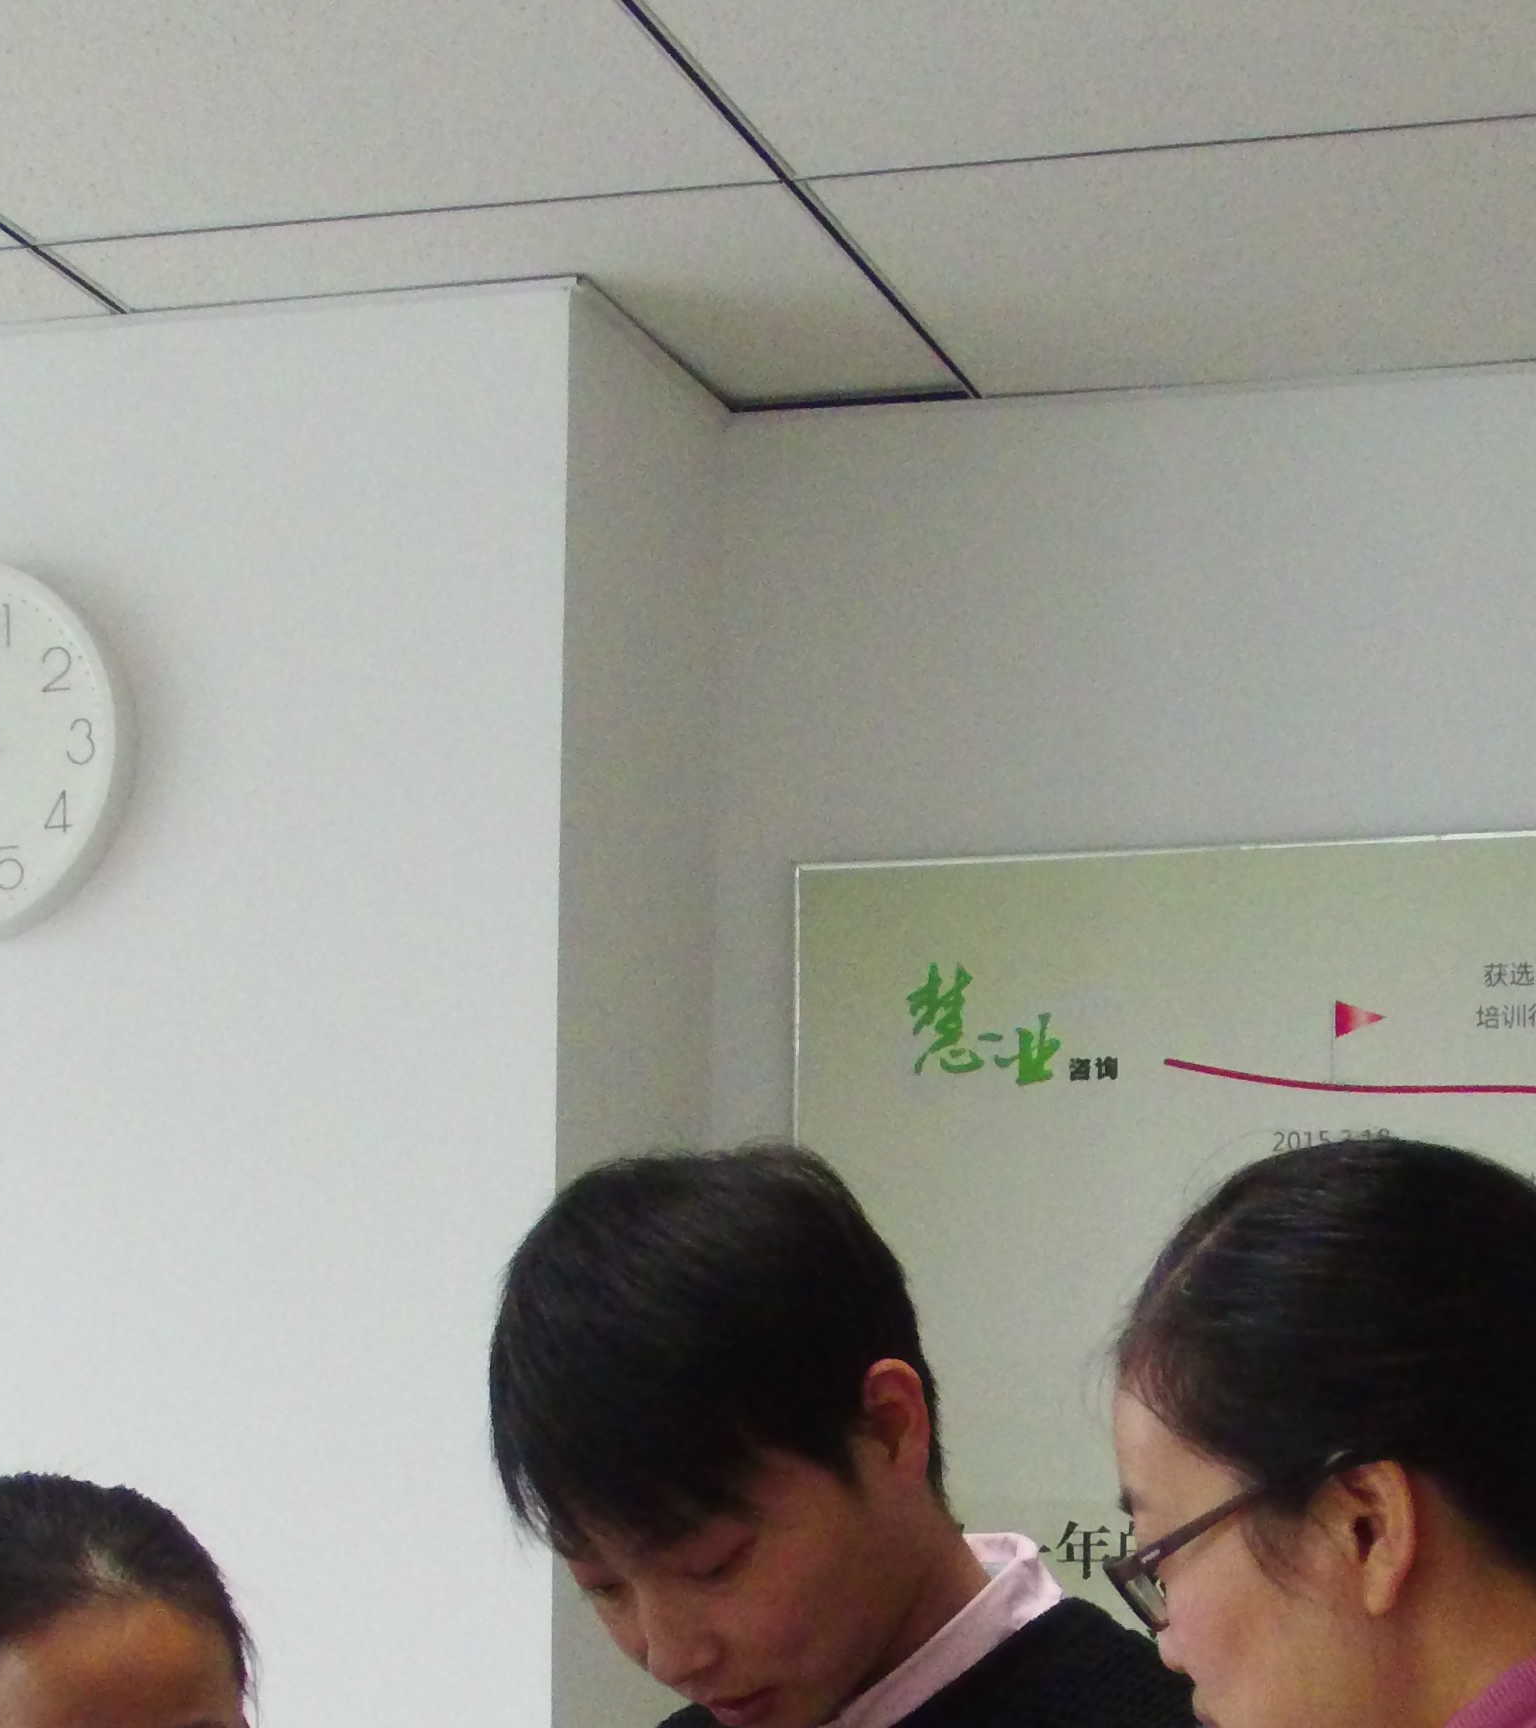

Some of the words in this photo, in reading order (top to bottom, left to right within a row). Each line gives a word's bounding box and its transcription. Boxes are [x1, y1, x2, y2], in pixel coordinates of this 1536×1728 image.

[2, 602, 11, 648] 1
[41, 645, 72, 693] 2
[66, 717, 96, 766] 3
[43, 789, 73, 834] 4
[1069, 1056, 1119, 1082] 咨询
